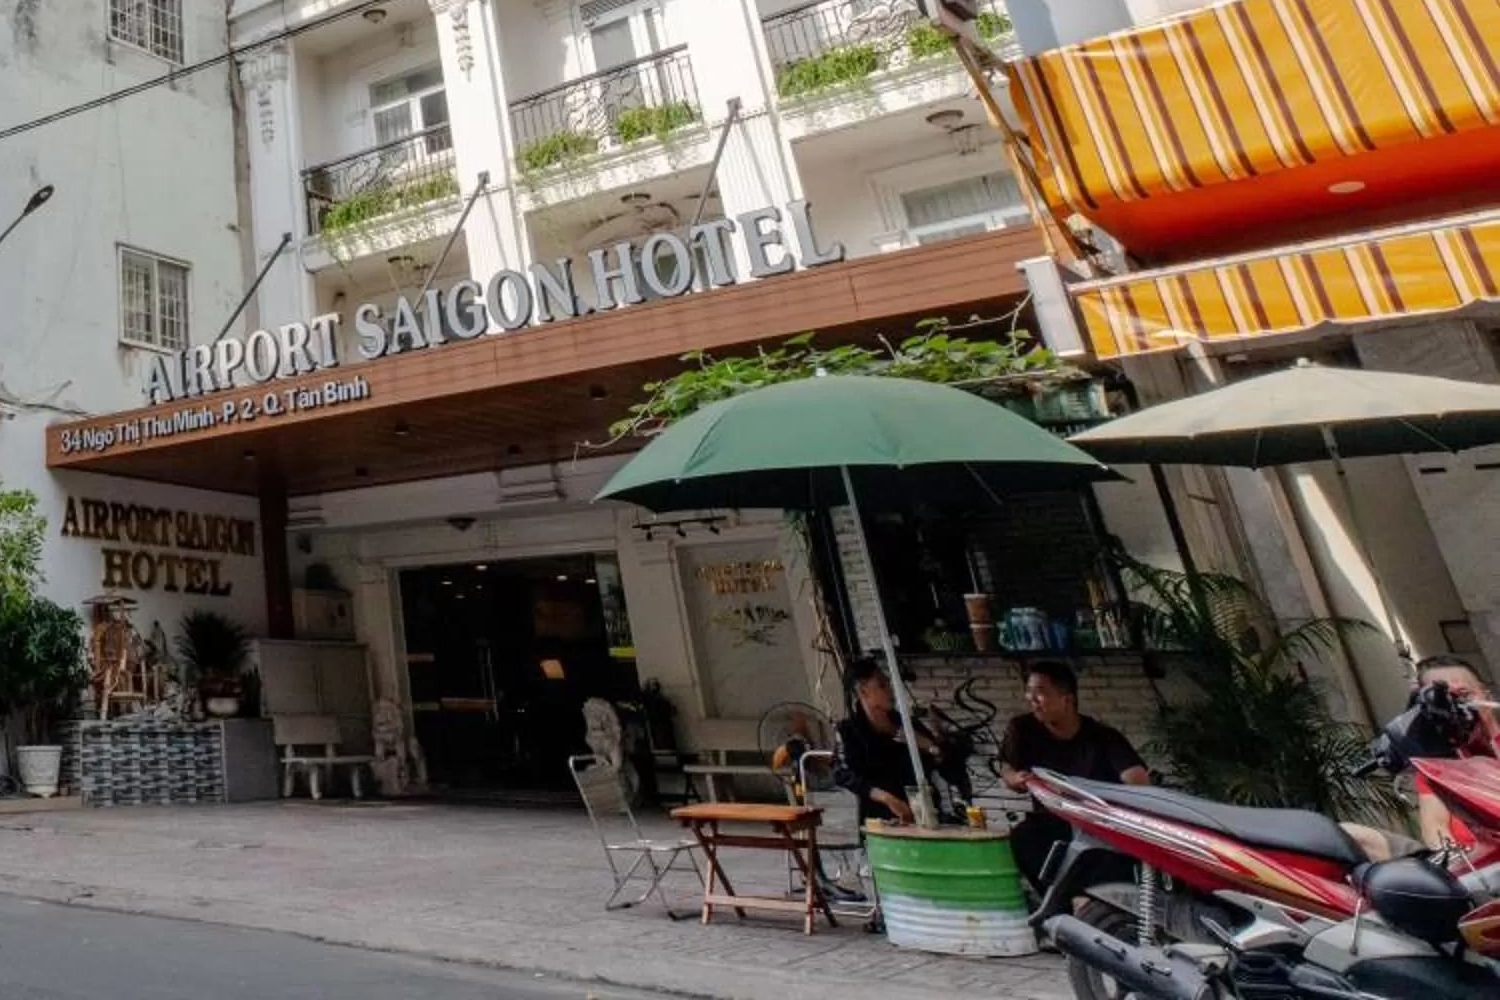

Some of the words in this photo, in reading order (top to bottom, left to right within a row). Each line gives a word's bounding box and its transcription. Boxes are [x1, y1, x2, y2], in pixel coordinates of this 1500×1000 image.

[141, 311, 343, 406] AIRPORT
[354, 257, 584, 361] SAIGON
[588, 201, 845, 309] HOTEL
[60, 429, 82, 453] 34
[115, 419, 141, 444] Thị
[141, 415, 172, 438] Thu
[173, 405, 216, 434] Minh
[240, 398, 255, 421] 2
[263, 393, 285, 416] Q.
[61, 496, 173, 548] AIRPORT
[174, 509, 256, 557] SAIGON
[101, 549, 233, 597] HOTEL
